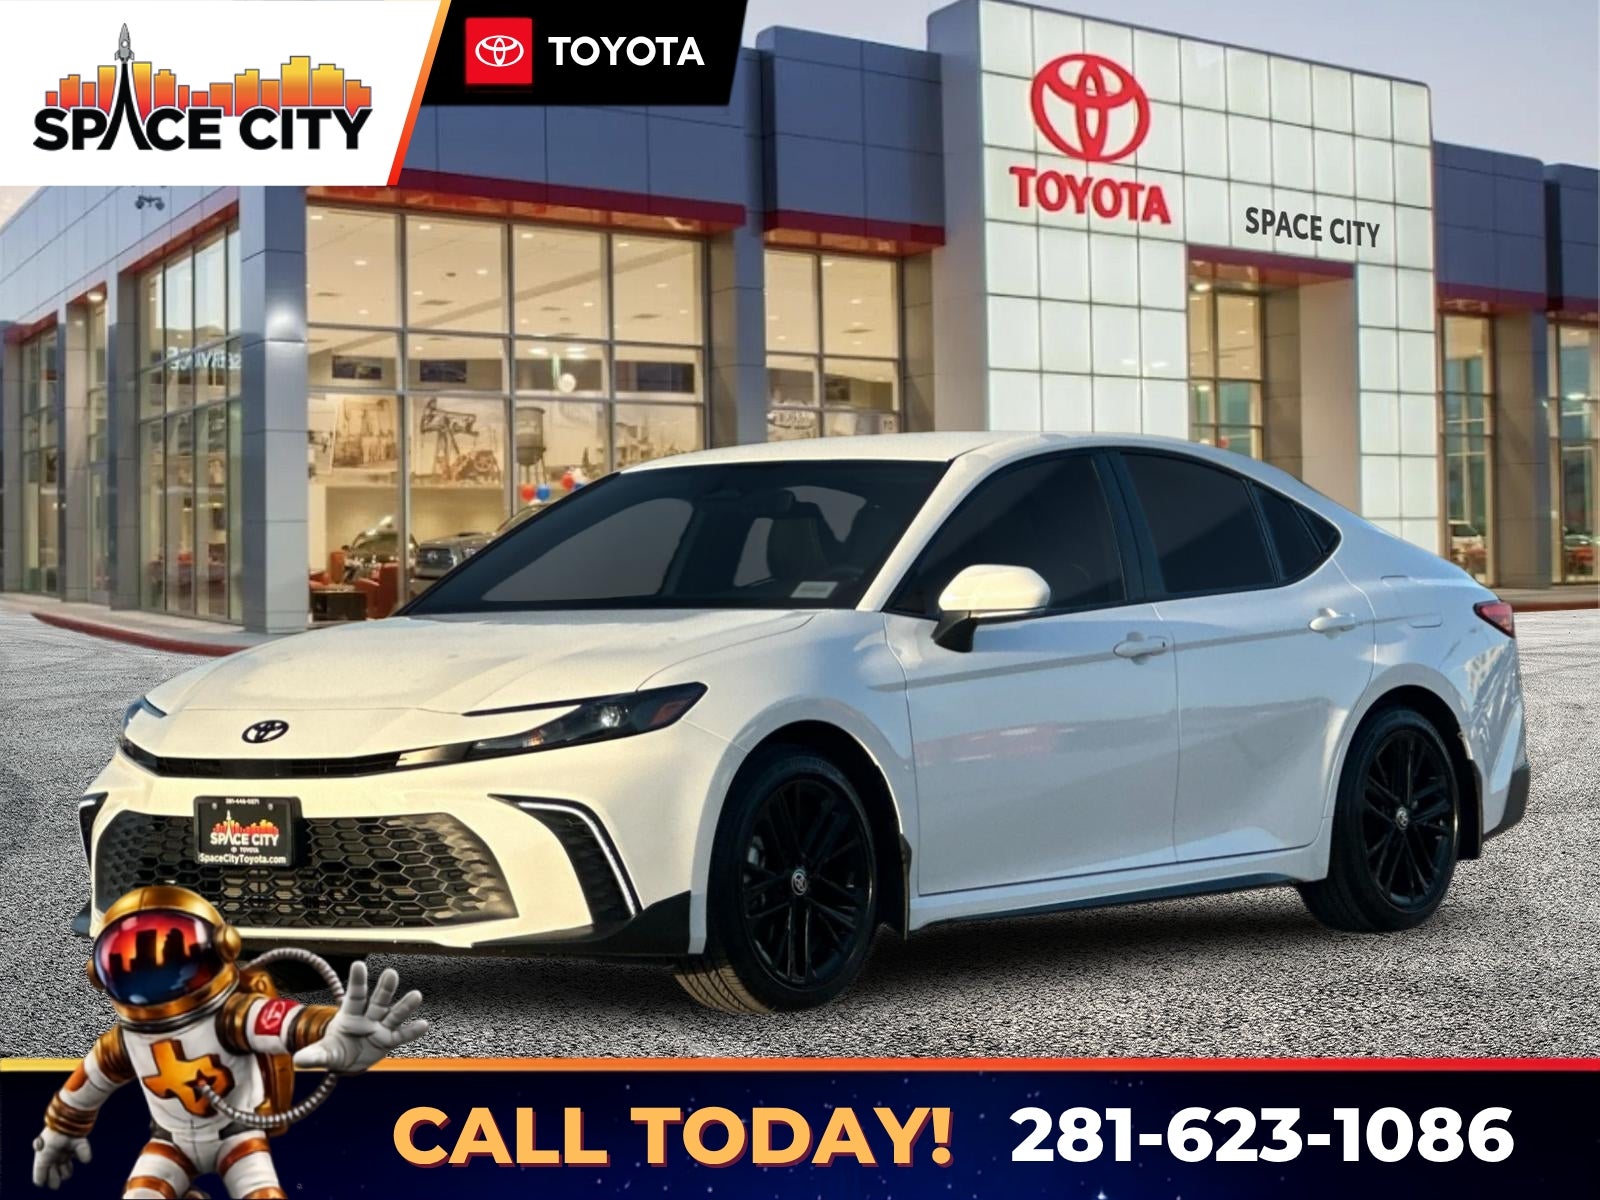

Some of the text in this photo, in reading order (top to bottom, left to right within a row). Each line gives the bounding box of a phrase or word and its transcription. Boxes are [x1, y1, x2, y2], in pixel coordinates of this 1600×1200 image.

[1010, 166, 1171, 224] TOYOTA
[1245, 206, 1381, 249] SPACE CITY
[210, 832, 279, 846] SPACE CITY
[199, 853, 287, 865] SpaceCityToyota.com
